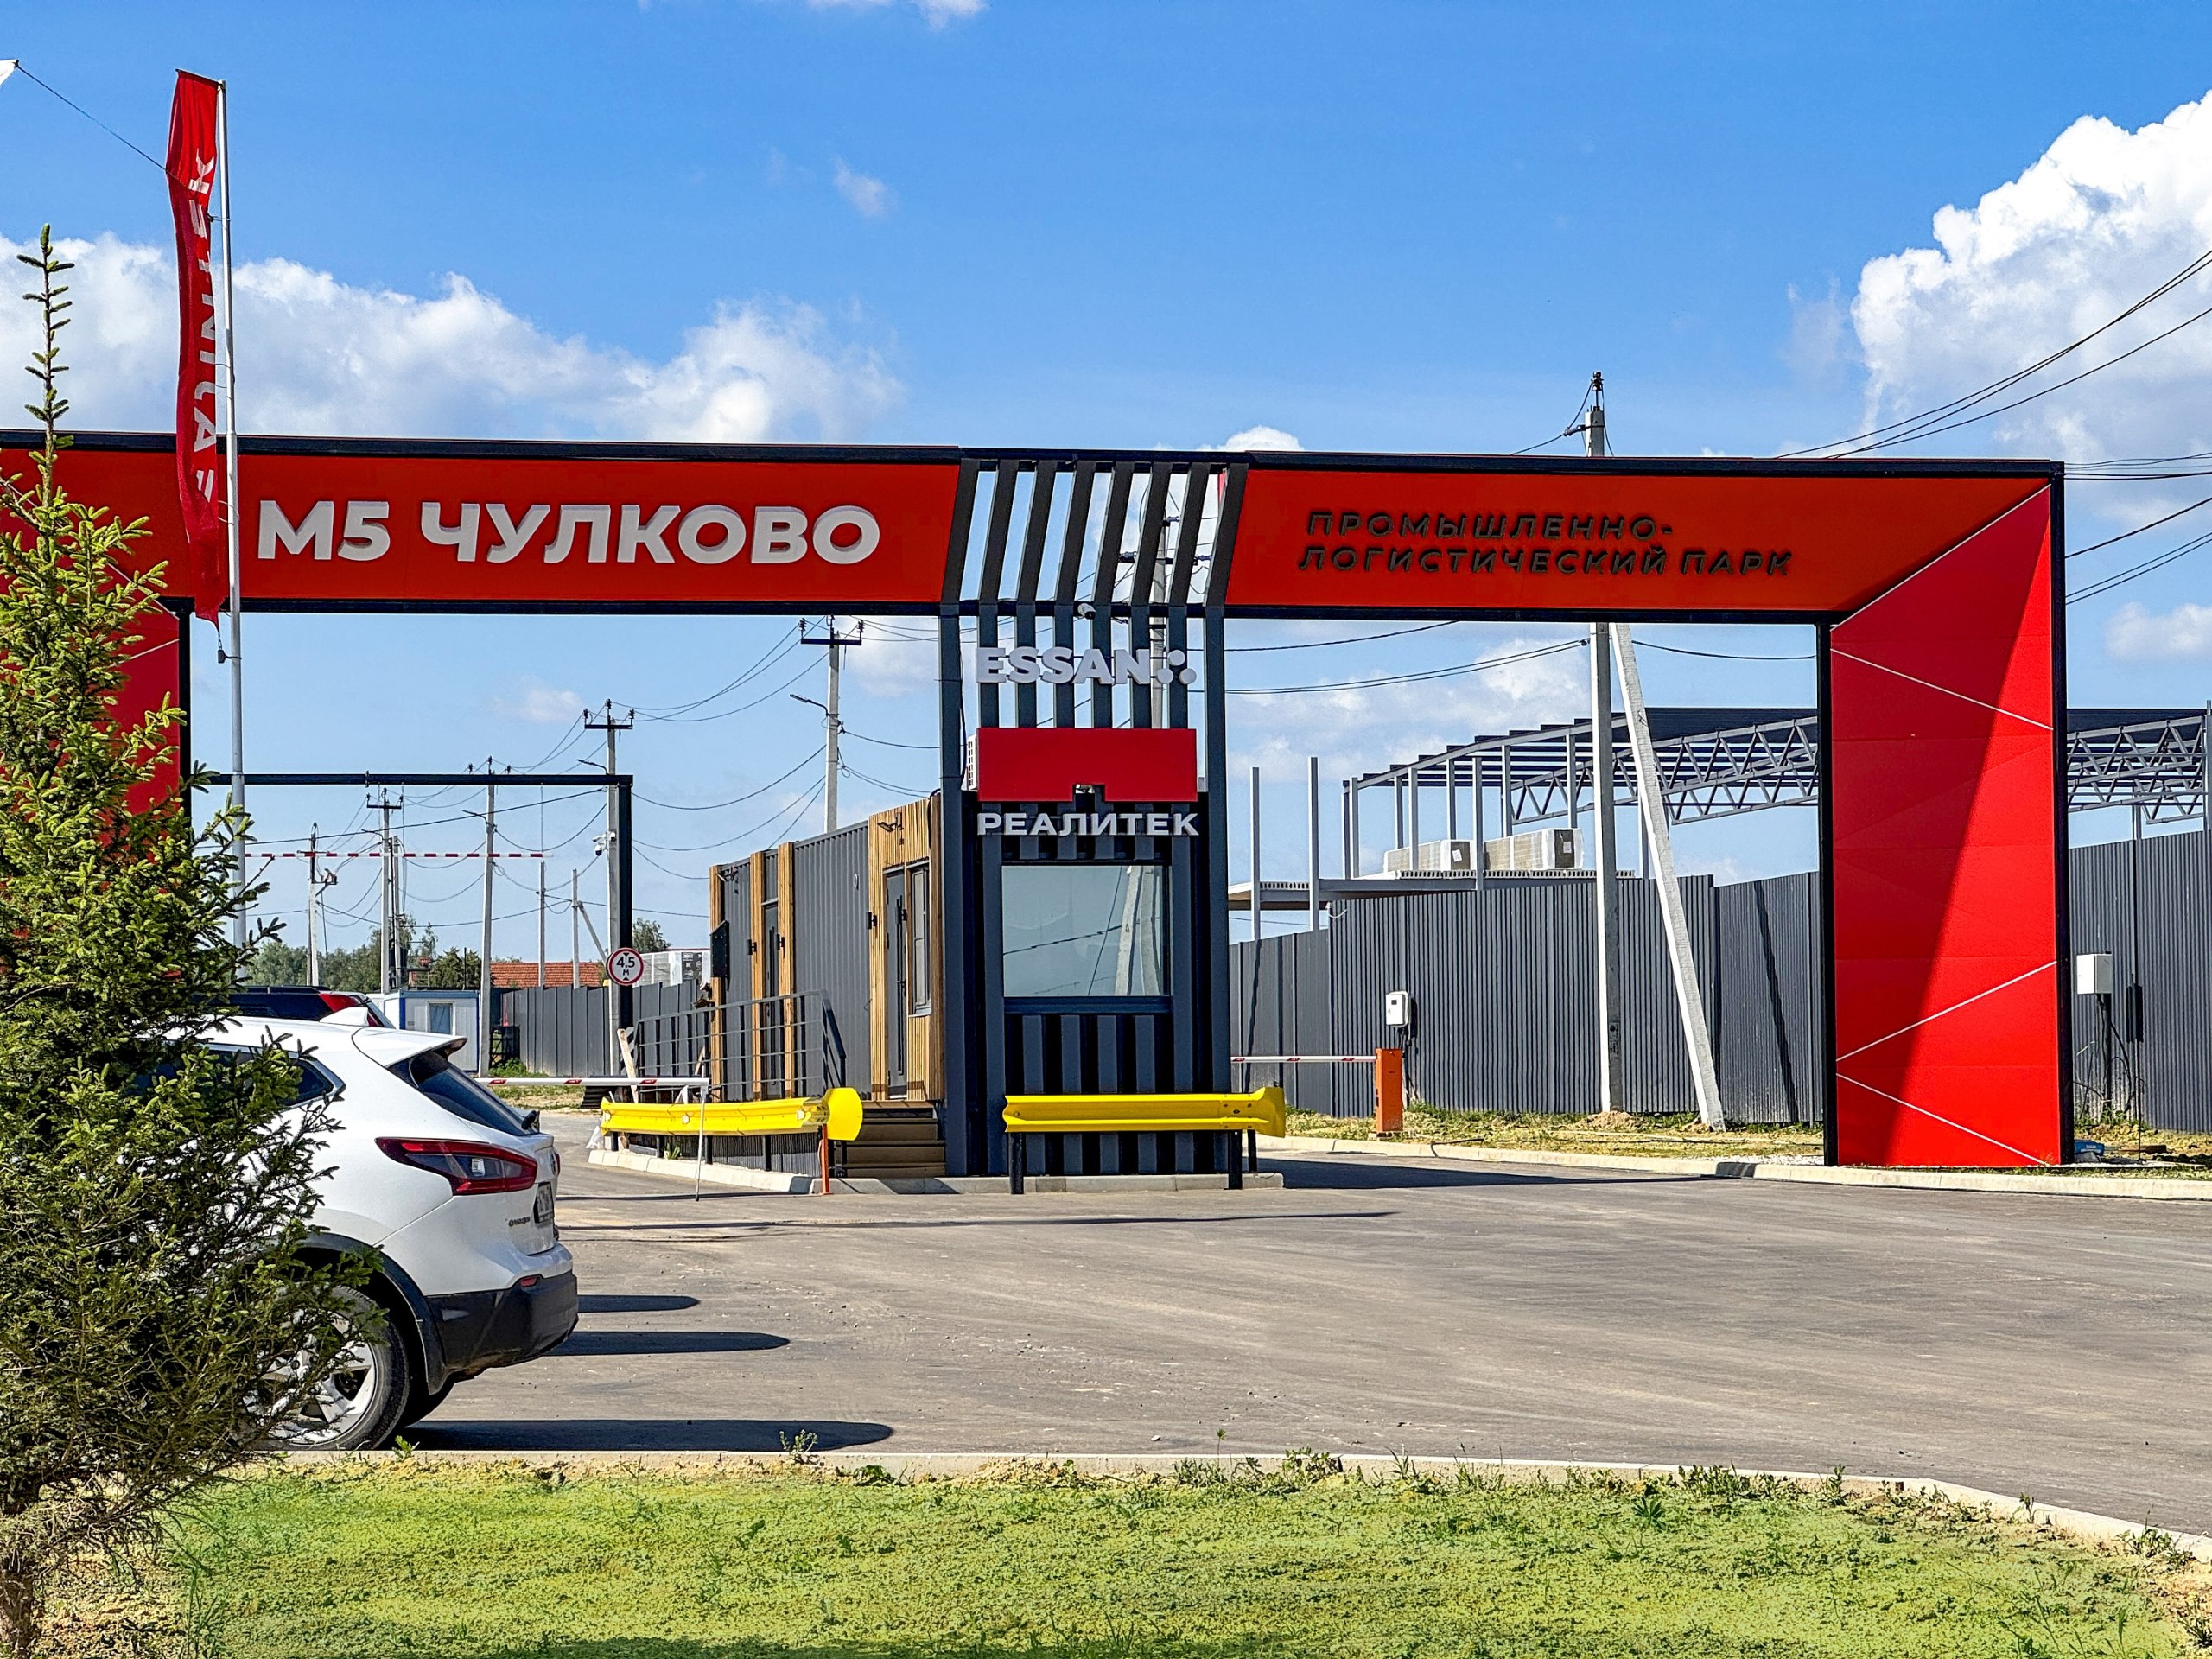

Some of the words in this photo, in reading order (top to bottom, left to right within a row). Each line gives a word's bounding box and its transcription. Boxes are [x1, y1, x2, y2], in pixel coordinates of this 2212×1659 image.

[257, 500, 391, 562] М5
[420, 501, 880, 564] ЧУЛКОВО
[1306, 511, 1674, 541] ПРОМЫШЛЕННО-
[1299, 546, 1669, 575] ЛОГИСТИЧЕСКИЙ
[1680, 550, 1793, 575] ПАРК
[975, 646, 1151, 685] ESSAN
[976, 812, 1199, 836] РЕАЛИТЕК
[616, 957, 635, 969] 4,5
